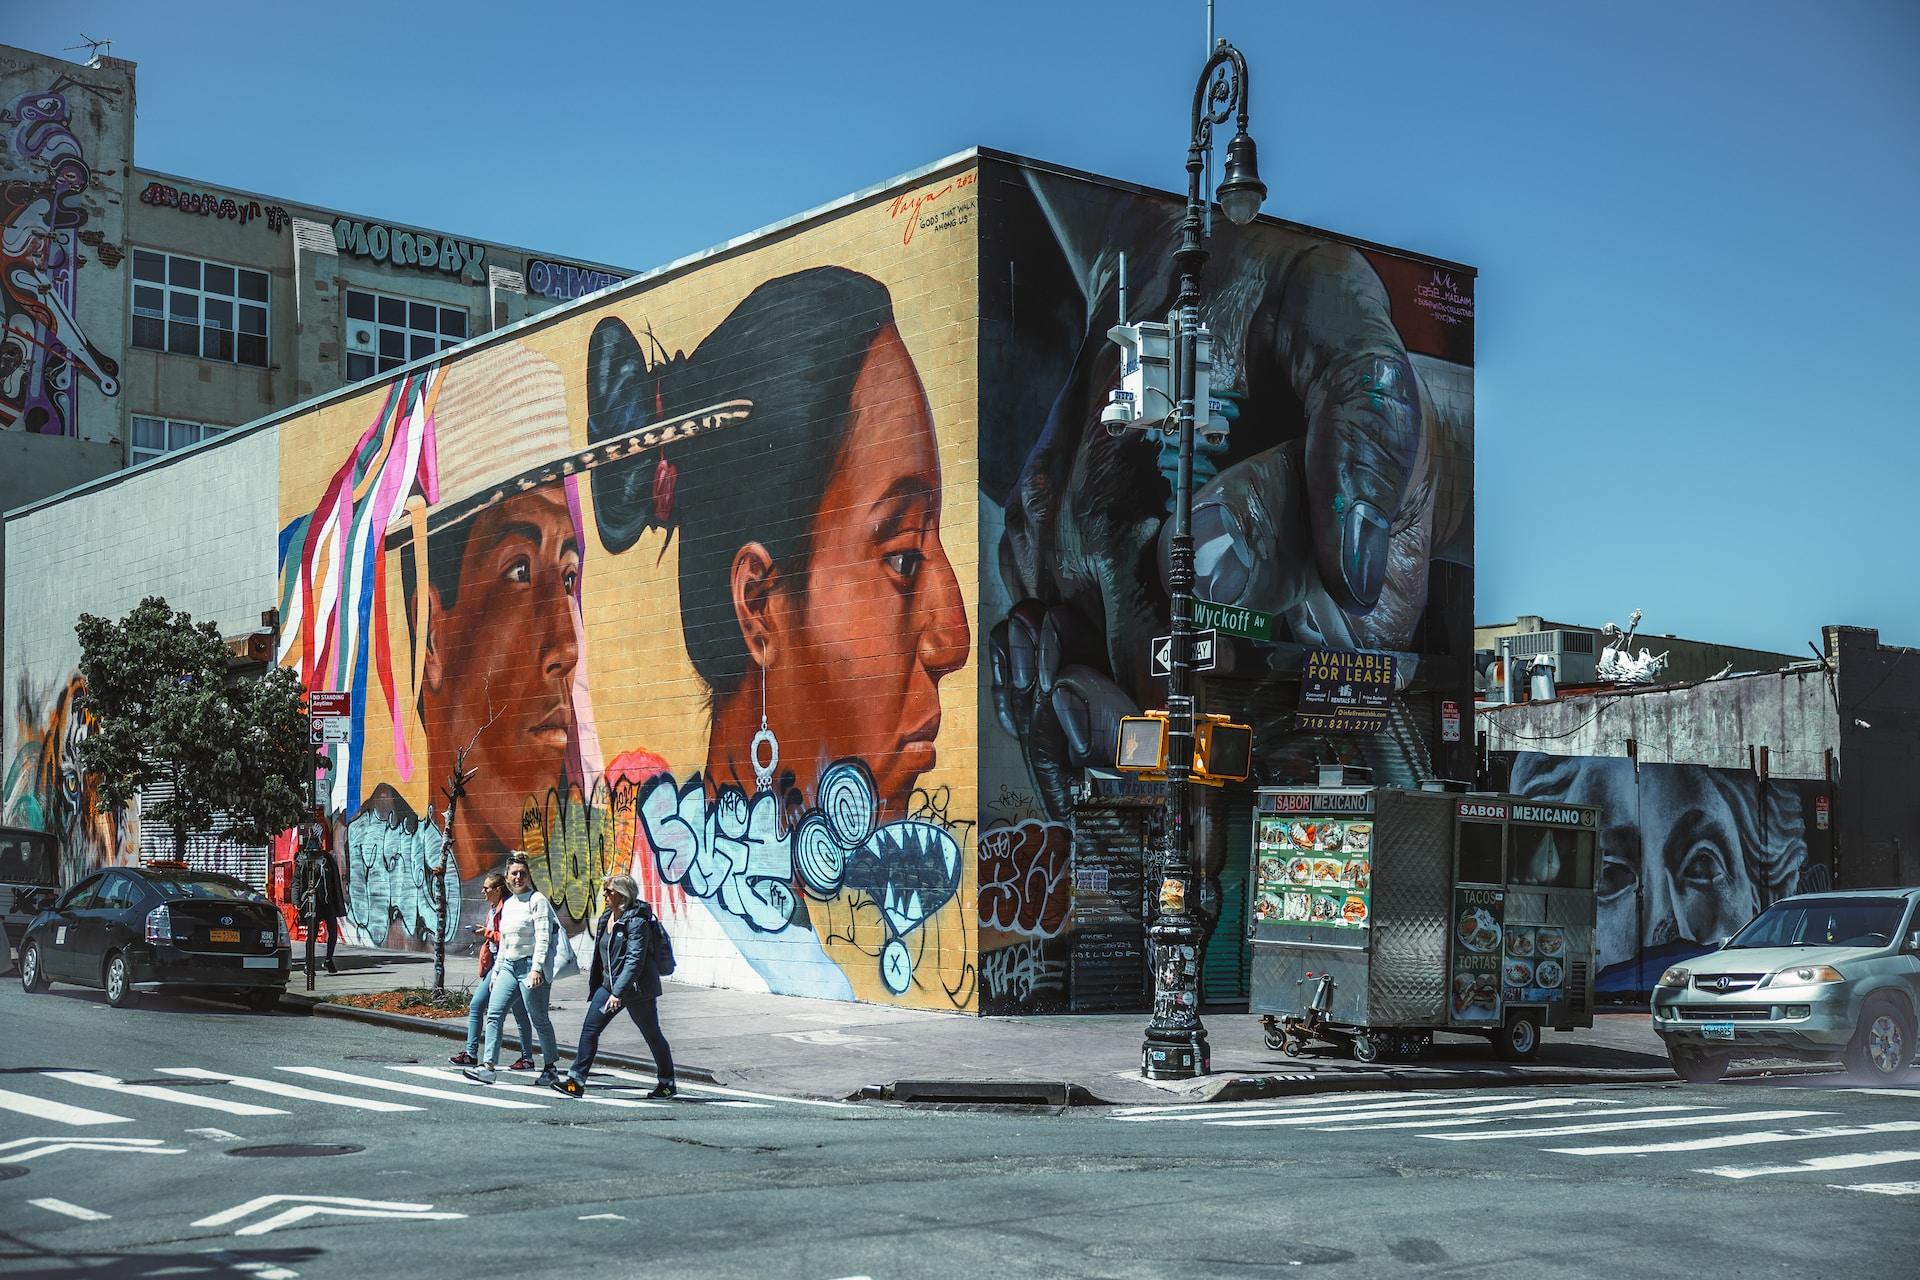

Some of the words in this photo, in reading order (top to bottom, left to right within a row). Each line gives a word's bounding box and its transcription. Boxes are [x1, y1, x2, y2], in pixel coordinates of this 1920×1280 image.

[941, 207, 956, 220] THAT
[957, 200, 976, 214] WALK
[934, 219, 957, 232] AMONG
[1208, 400, 1220, 409] YPD
[1194, 603, 1250, 632] Wyckoff
[1254, 615, 1265, 628] Av
[1309, 650, 1391, 670] AVAILABLE
[1308, 665, 1339, 681] FOR
[1345, 668, 1391, 684] LEASE
[1276, 795, 1310, 810] SABOR
[1313, 795, 1366, 810] MEXICANO
[1460, 804, 1505, 818] SABOR
[1512, 806, 1580, 824] MEXICANO
[1584, 810, 1592, 825] 3
[1463, 890, 1496, 905] TACOS
[1458, 955, 1497, 970] TORTAS
